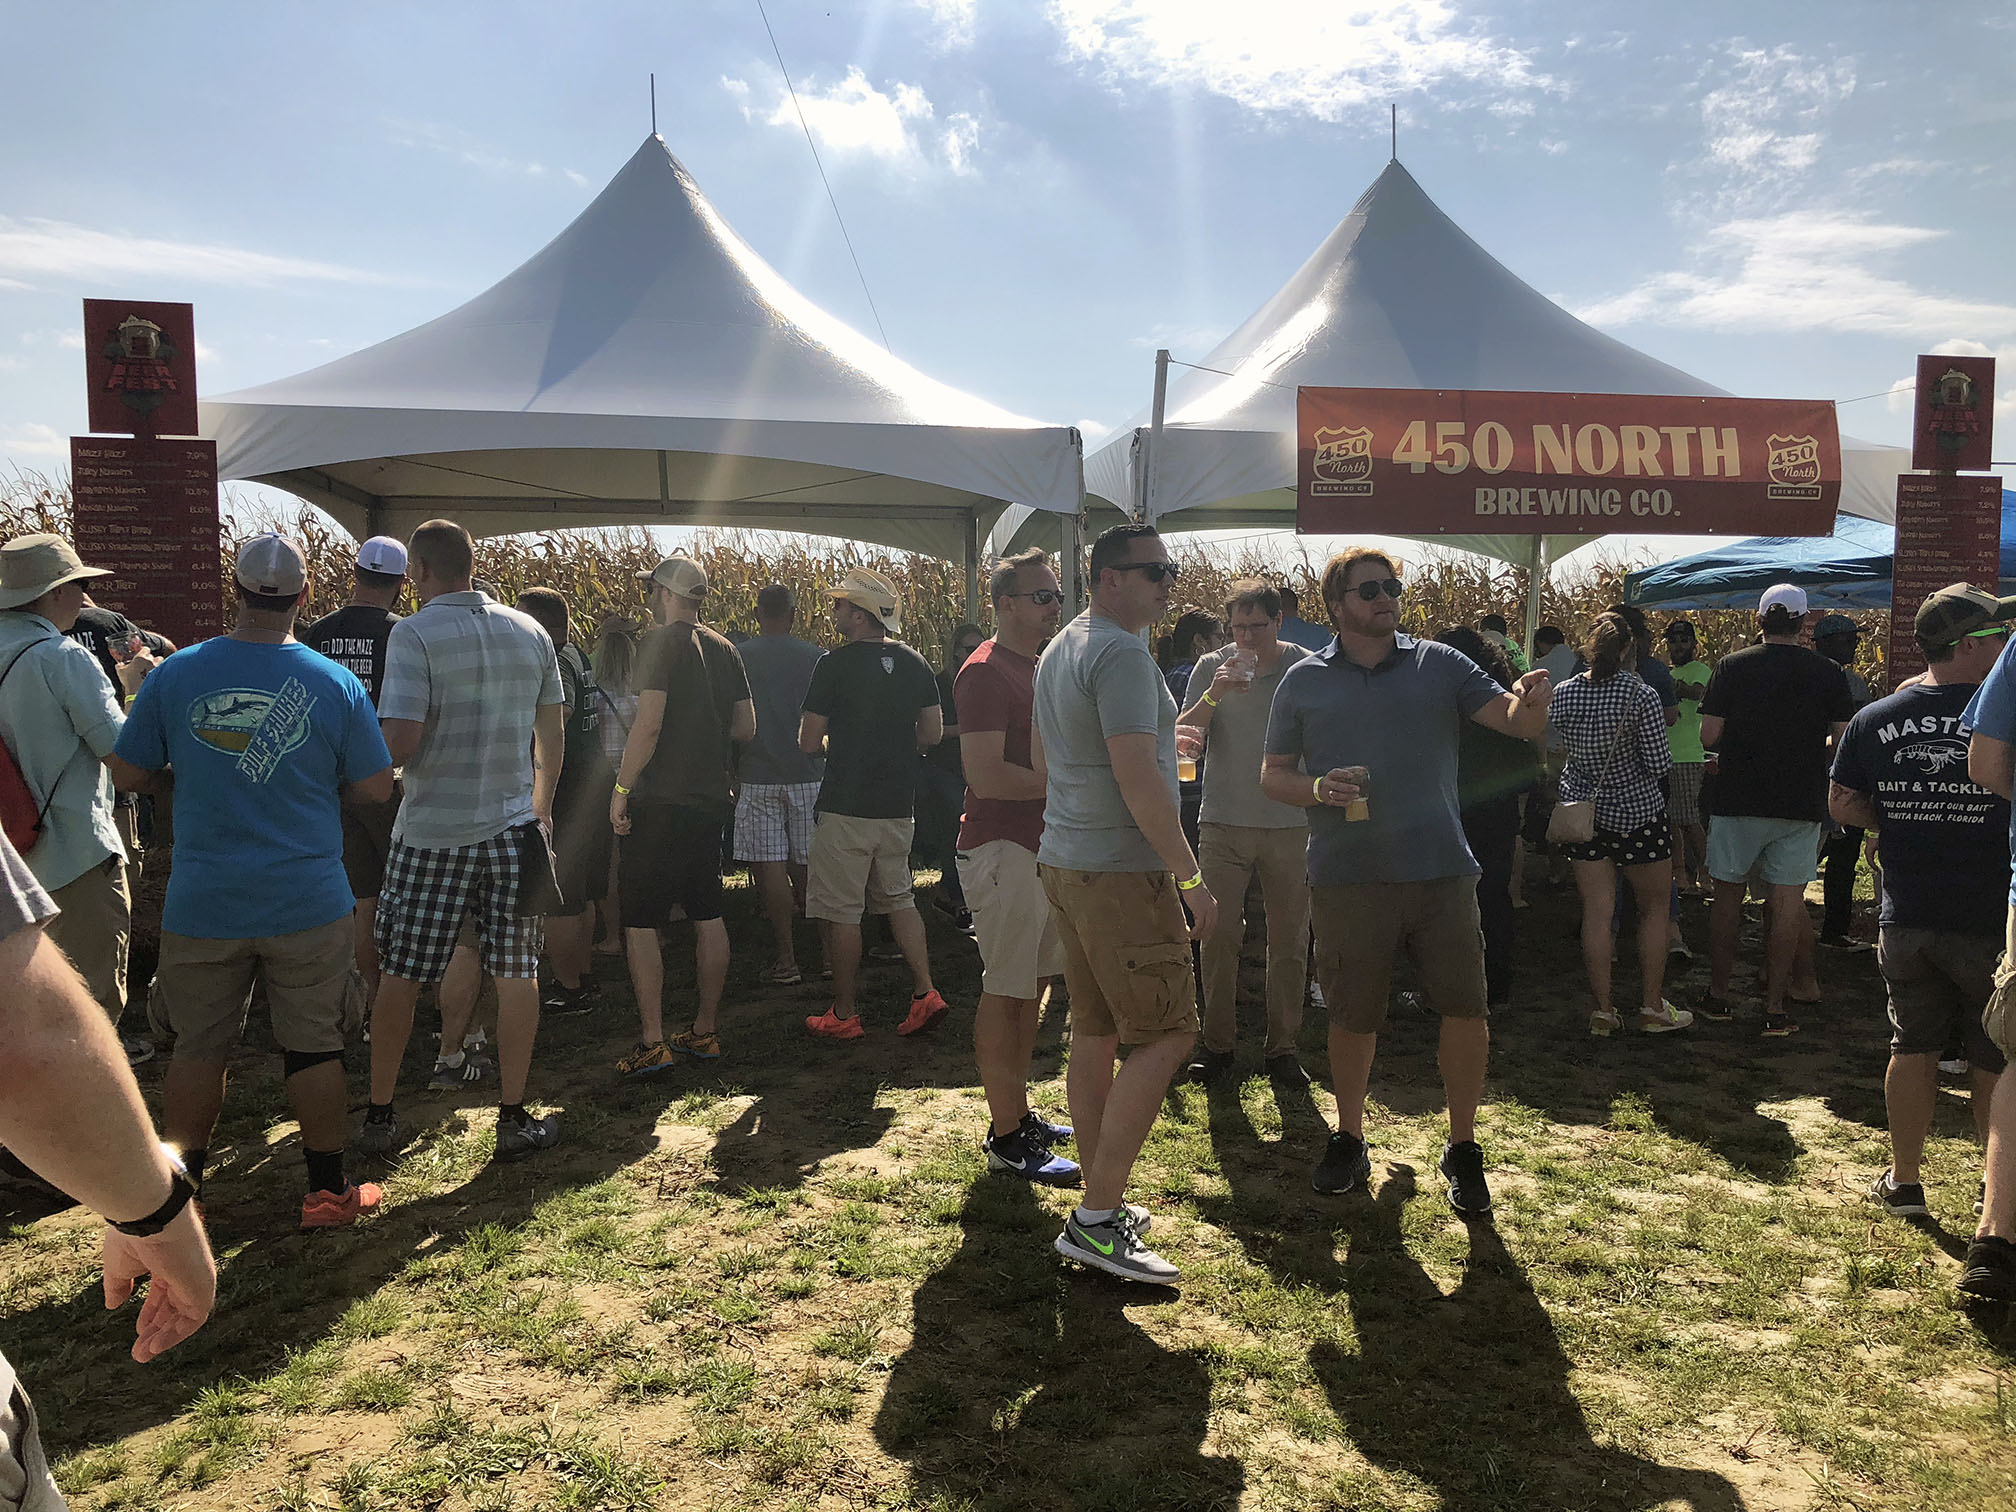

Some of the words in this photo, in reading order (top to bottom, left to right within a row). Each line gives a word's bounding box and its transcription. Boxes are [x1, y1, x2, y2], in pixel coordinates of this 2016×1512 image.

[107, 377, 177, 390] FEST
[1318, 438, 1368, 461] 450
[1391, 420, 1515, 475] 450
[1532, 422, 1741, 478] NORTH
[1771, 445, 1814, 466] 450
[1329, 461, 1366, 473] North
[1782, 465, 1816, 478] North
[1473, 487, 1623, 517] BREWING
[1631, 488, 1683, 518] CO.
[191, 581, 217, 591] 9.0%
[331, 638, 344, 655] DID
[344, 638, 356, 655] THE
[356, 638, 374, 656] MAZE
[360, 658, 373, 675] BEER
[241, 735, 273, 783] GULF
[265, 676, 308, 743] SHORES
[1877, 781, 1908, 792] BAIT
[1912, 782, 1923, 793] &
[1895, 801, 1920, 809] CAN'T
[1921, 802, 1945, 810] BEAT
[1946, 803, 1965, 811] OUR
[1913, 812, 1944, 822] BEACH,
[1946, 814, 1985, 824] FLORIDA
